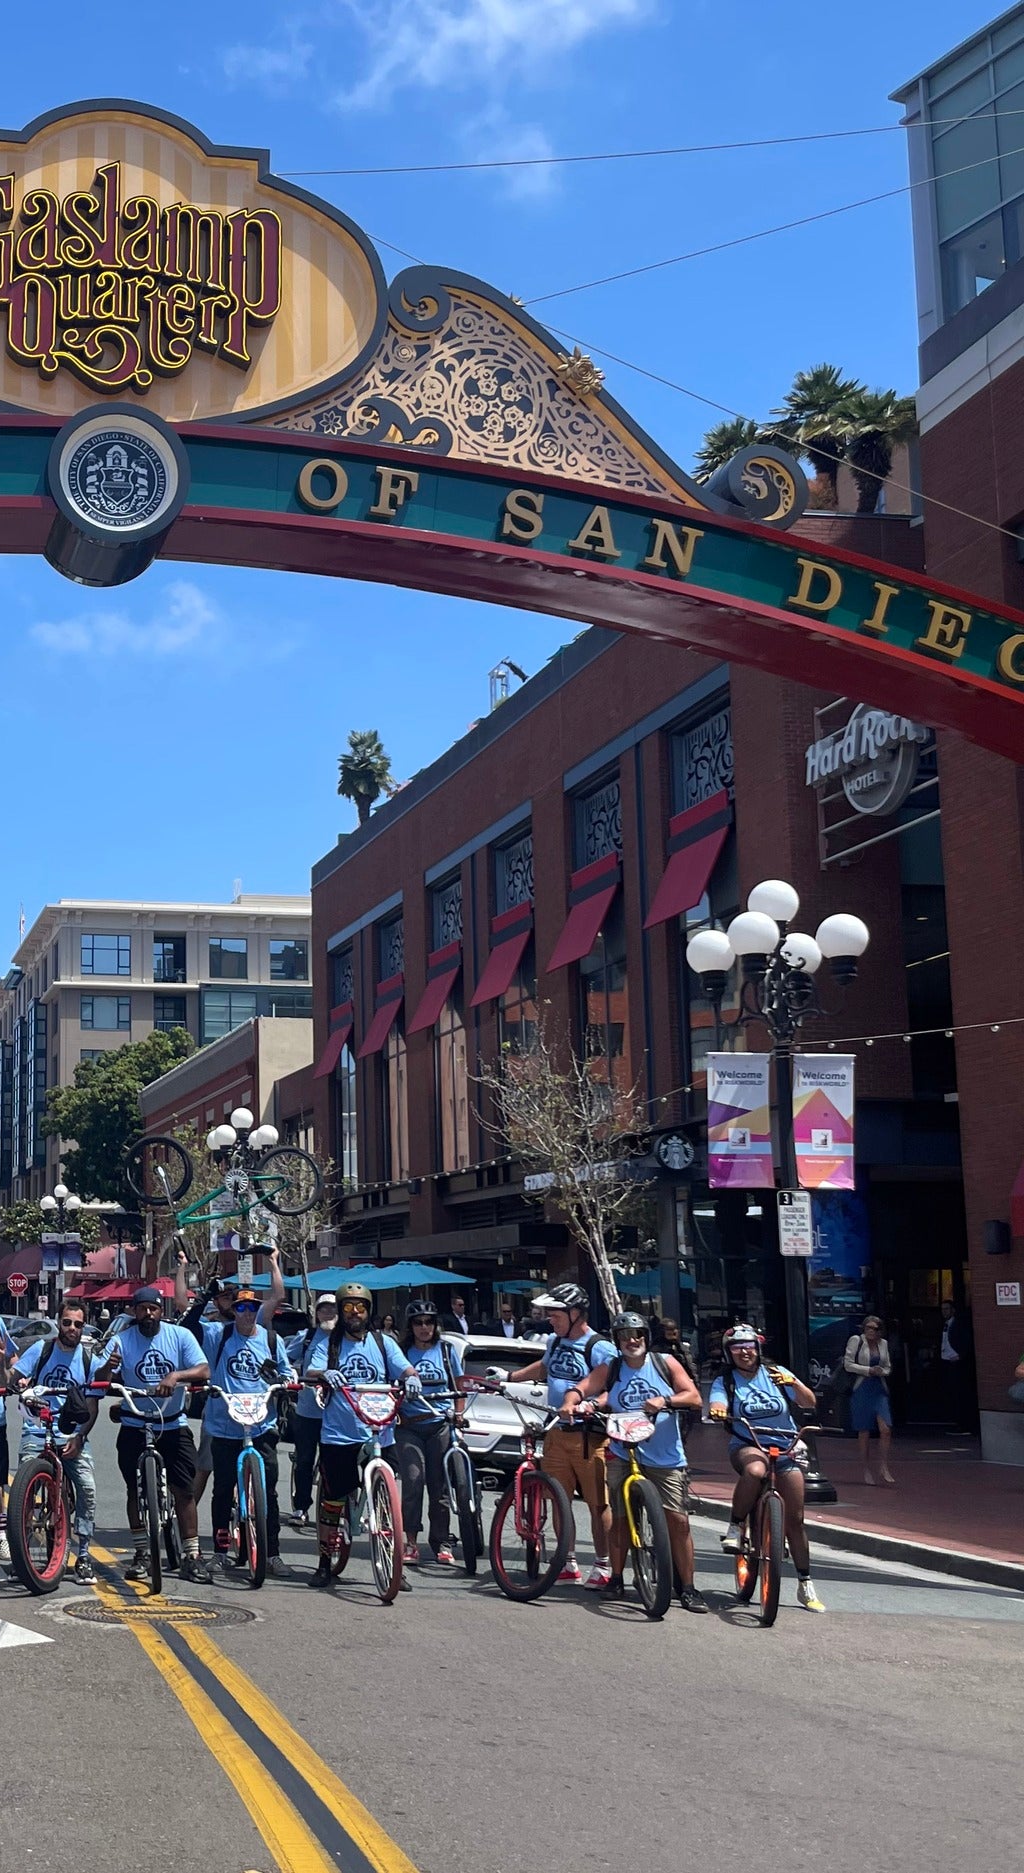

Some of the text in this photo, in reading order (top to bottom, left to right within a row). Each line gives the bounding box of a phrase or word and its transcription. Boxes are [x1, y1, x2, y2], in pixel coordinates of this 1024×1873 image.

[9, 272, 230, 386] Quarter
[77, 440, 91, 456] SAN
[91, 433, 119, 445] DIEGO
[124, 434, 149, 450] STATE
[148, 461, 166, 515] CALIFORNIA
[298, 458, 419, 518] OF
[501, 488, 705, 578] SAN
[805, 718, 856, 787] Hard
[847, 769, 878, 795] HOTEL
[716, 1070, 763, 1079] Welcome
[801, 1071, 846, 1080] Welcome
[783, 1193, 790, 1205] 3
[9, 1279, 27, 1287] STOP
[998, 1285, 1017, 1296] FDC
[145, 1366, 166, 1374] BIKES
[236, 1363, 256, 1374] BIKES
[348, 1358, 366, 1370] SE
[417, 1362, 433, 1373] SE
[628, 1381, 648, 1394] SE
